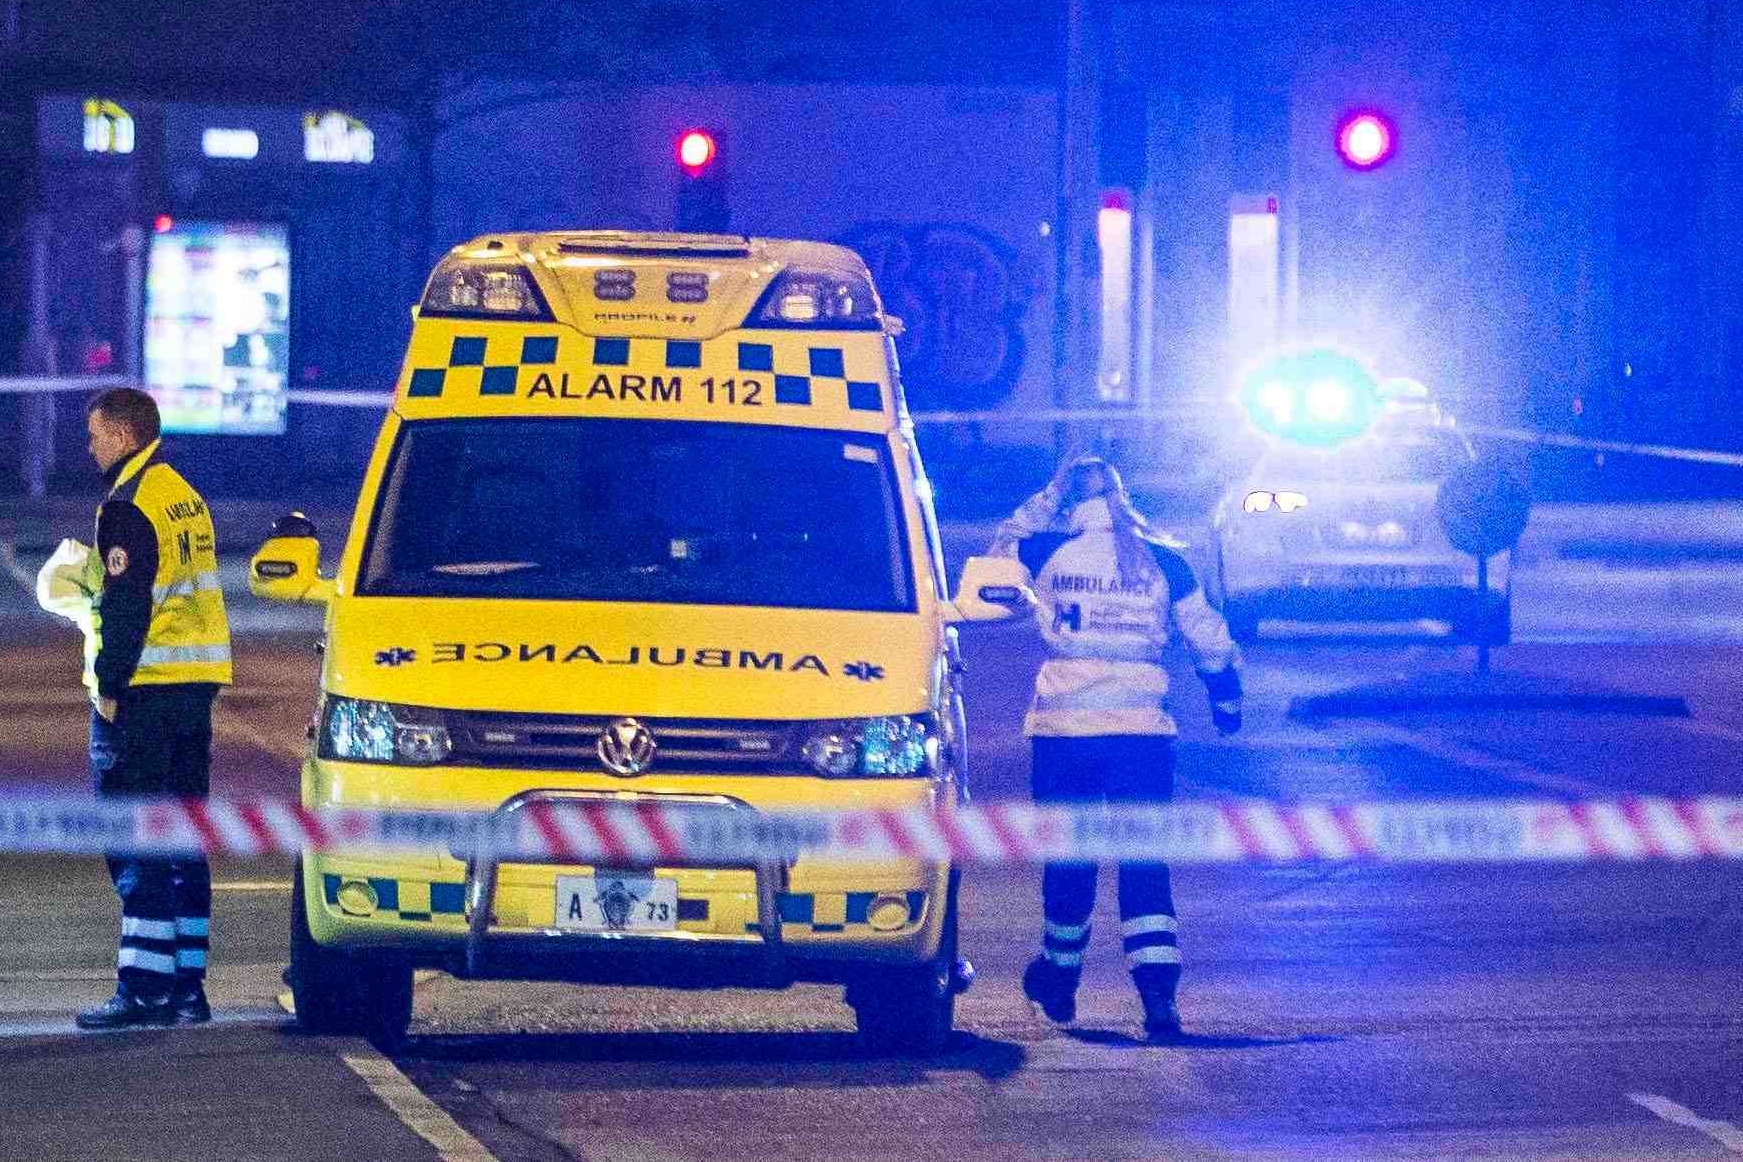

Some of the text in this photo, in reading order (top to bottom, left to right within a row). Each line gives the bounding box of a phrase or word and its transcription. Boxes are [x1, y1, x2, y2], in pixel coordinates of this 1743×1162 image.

[527, 372, 763, 406] ALARM 112
[568, 892, 583, 921] A
